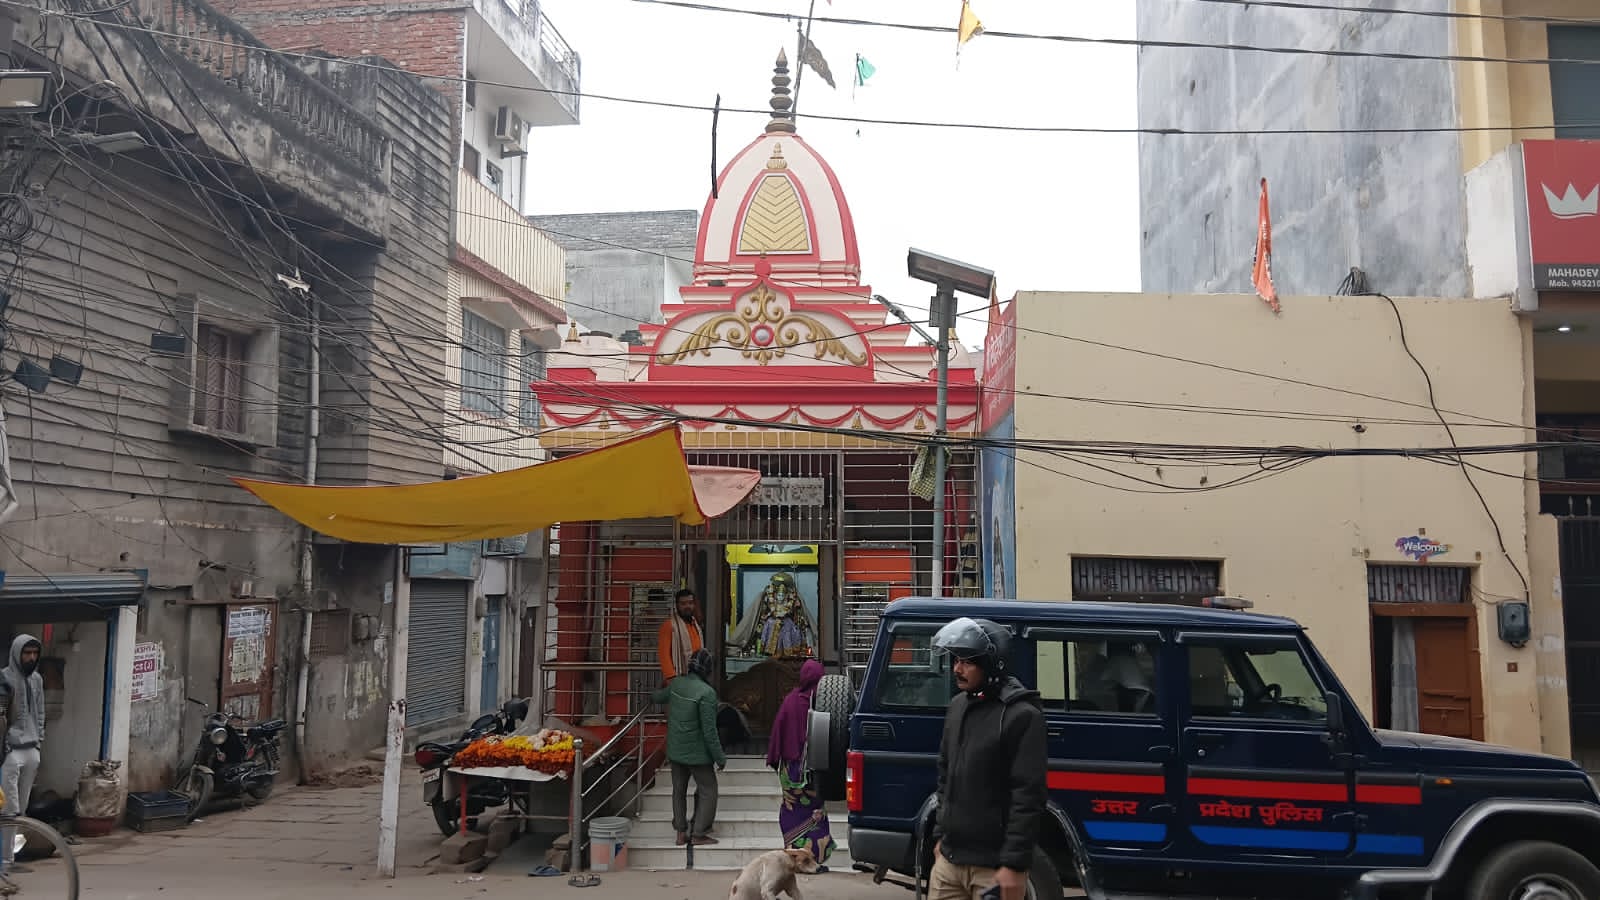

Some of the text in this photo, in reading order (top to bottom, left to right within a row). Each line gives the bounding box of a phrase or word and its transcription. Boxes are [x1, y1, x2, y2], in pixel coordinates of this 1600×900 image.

[1548, 268, 1599, 278] MAHADEV
[1549, 279, 1570, 288] Mob.
[1404, 541, 1448, 552] Welcome
[1091, 799, 1323, 825] उत्तर प्रदेश पुलिस
